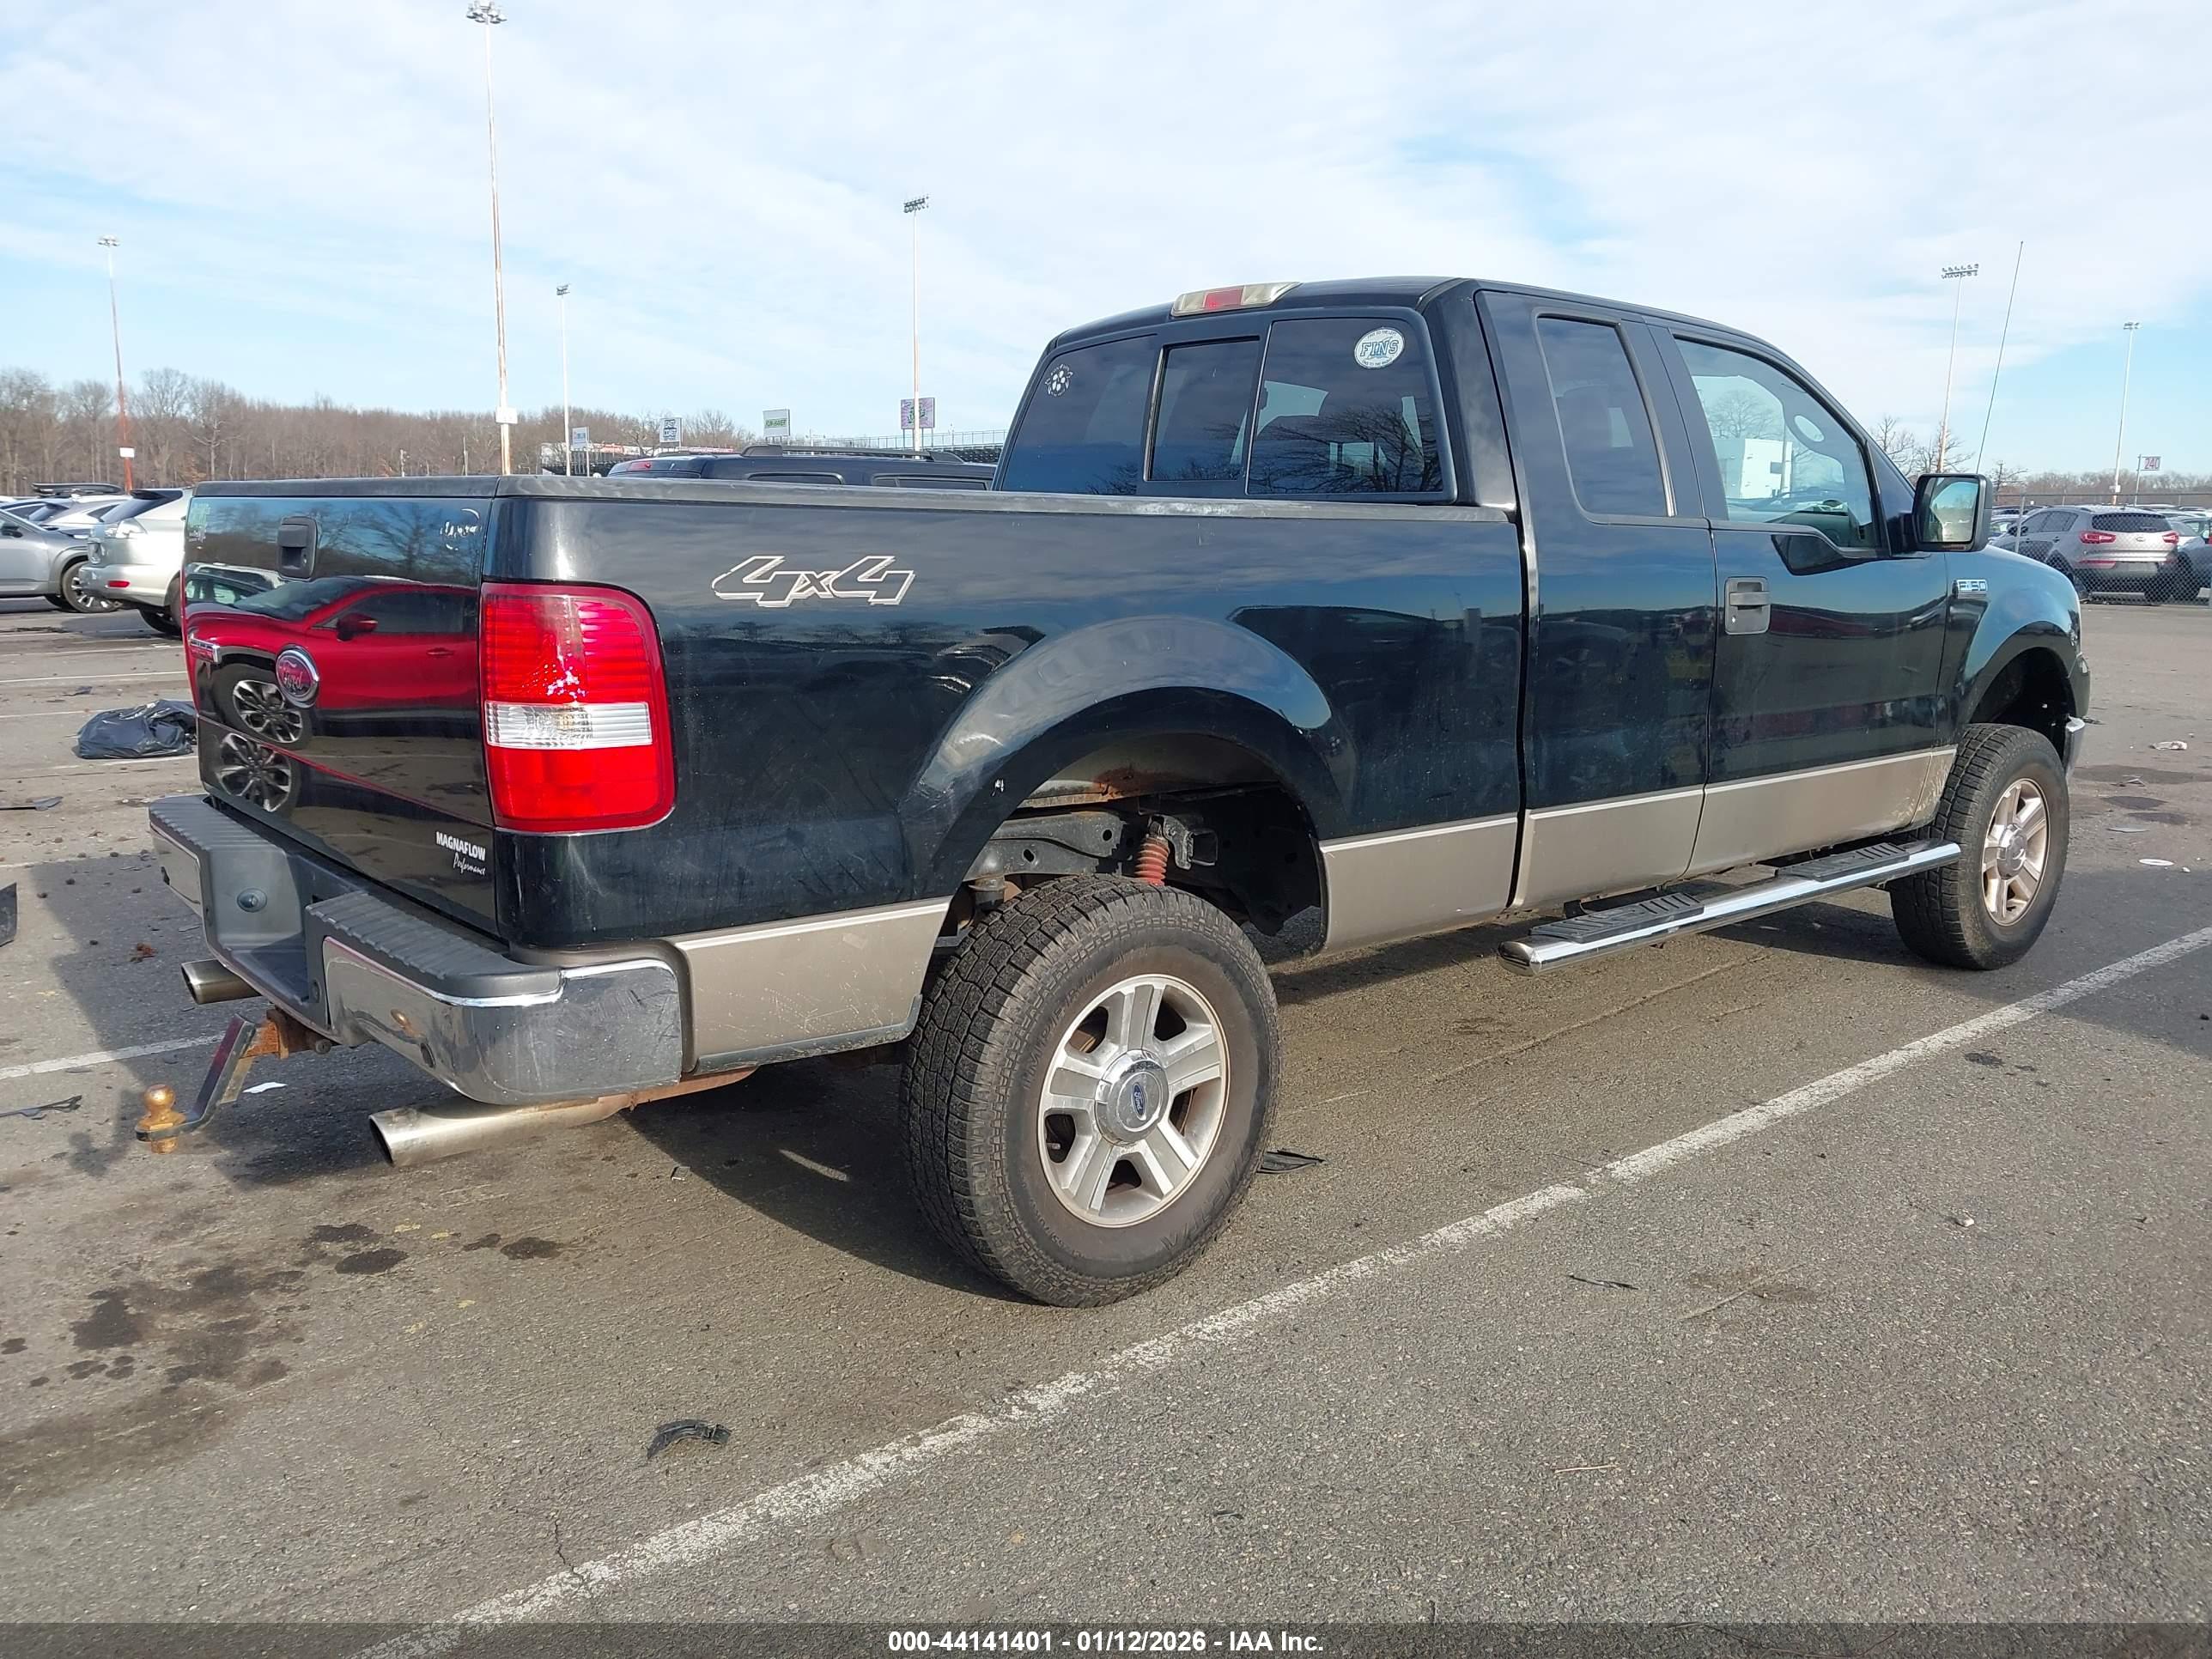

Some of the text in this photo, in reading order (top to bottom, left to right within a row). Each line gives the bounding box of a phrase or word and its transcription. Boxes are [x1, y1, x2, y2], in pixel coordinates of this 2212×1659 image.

[1360, 339, 1399, 357] FINS
[2144, 458, 2160, 470] 240
[436, 831, 486, 861] MAGNAFLOW
[453, 852, 486, 876] Performance
[1134, 1091, 1143, 1110] Ford
